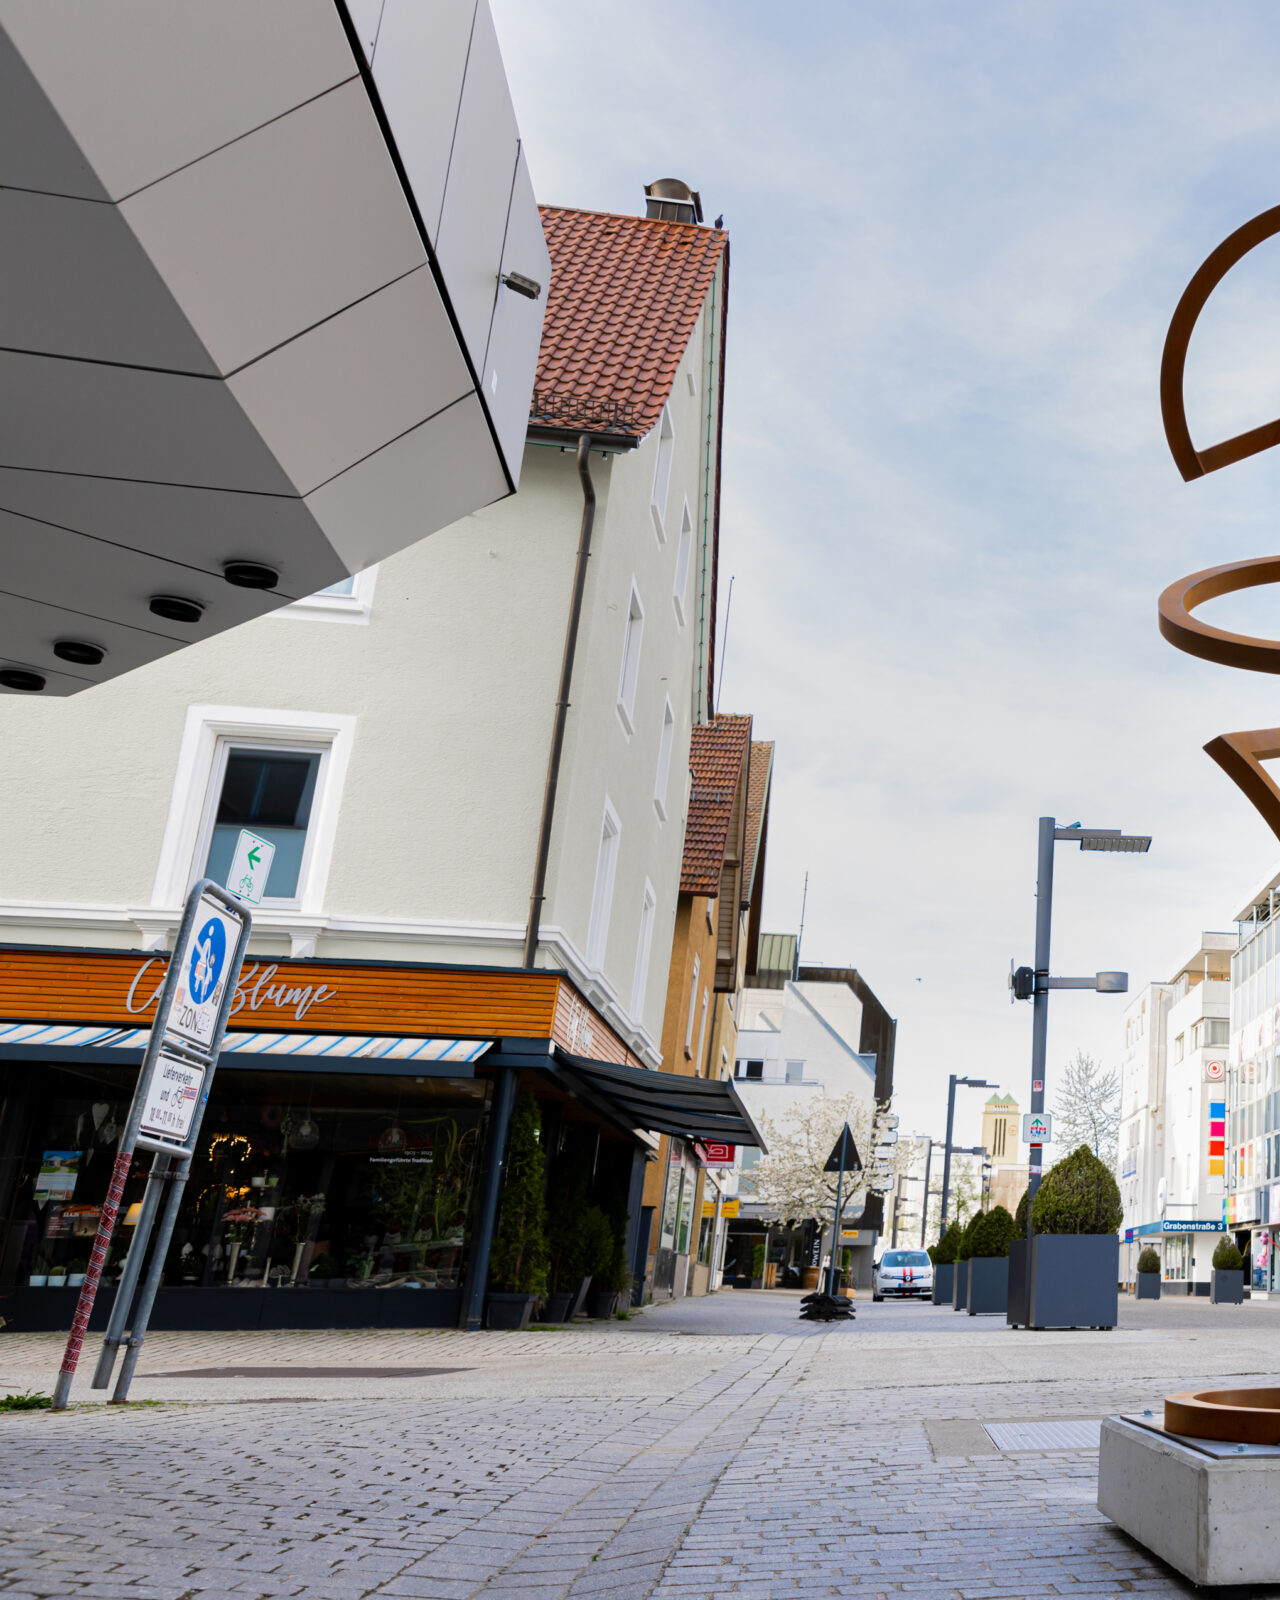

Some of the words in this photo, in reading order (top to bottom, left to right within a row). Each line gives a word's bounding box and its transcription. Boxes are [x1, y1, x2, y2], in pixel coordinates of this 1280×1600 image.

[178, 1004, 202, 1035] ZON
[162, 1063, 195, 1086] Lieferverkehr
[160, 1088, 171, 1102] und
[1163, 1221, 1216, 1231] Grabenstraße
[1217, 1222, 1223, 1230] 3
